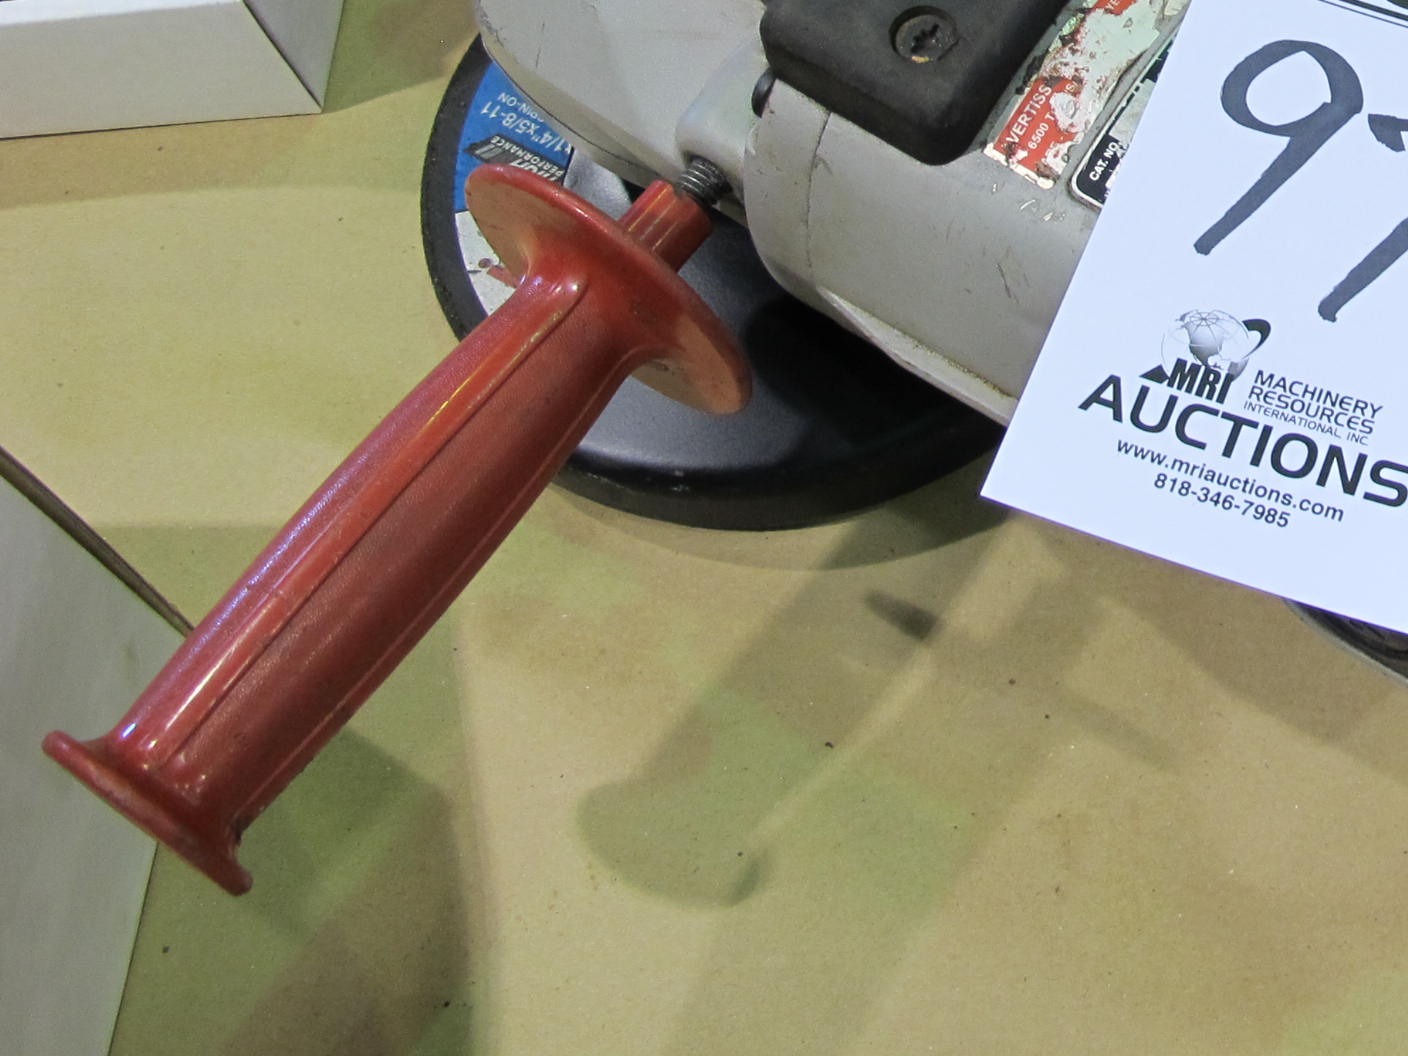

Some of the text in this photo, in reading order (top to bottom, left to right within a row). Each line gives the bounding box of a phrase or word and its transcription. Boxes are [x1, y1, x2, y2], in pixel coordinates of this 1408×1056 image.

[1007, 83, 1053, 143] VERTISS
[1028, 122, 1050, 150] 6500
[490, 134, 566, 177] PERFORMANCE
[1089, 158, 1109, 181] CAT.
[1167, 357, 1235, 405] MRI
[1253, 369, 1384, 419] MACHINERY
[1243, 399, 1342, 439] INTERNATIONAL
[1248, 385, 1376, 435] RESOURCES
[1116, 438, 1345, 523] www.mriauctions.com
[1153, 472, 1291, 529] 818-346-7985
